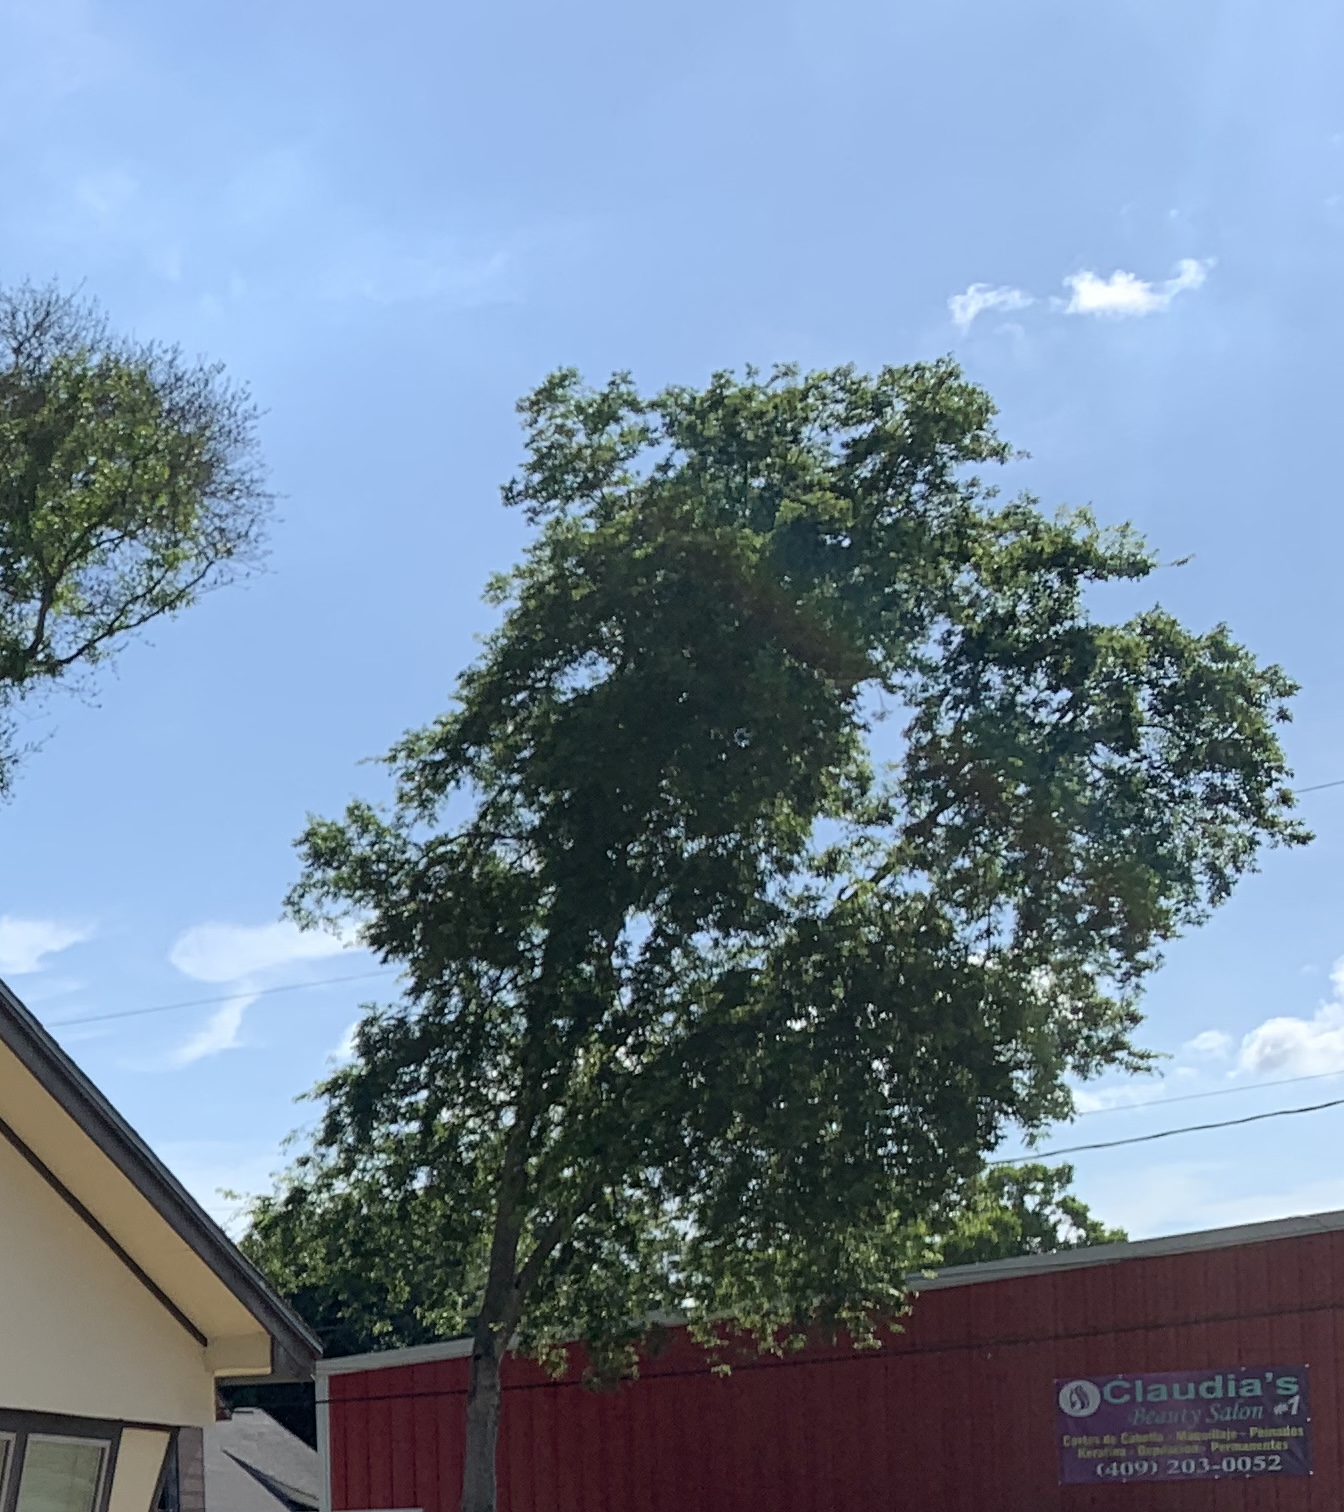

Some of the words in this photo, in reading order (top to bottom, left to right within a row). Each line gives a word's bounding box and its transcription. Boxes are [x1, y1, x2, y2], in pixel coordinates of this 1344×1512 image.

[1103, 1371, 1300, 1405] Claudia's
[1132, 1406, 1202, 1430] Beauty
[1205, 1399, 1264, 1424] Salon
[1096, 1460, 1158, 1478] (409)
[1166, 1454, 1283, 1475] 203-0052
